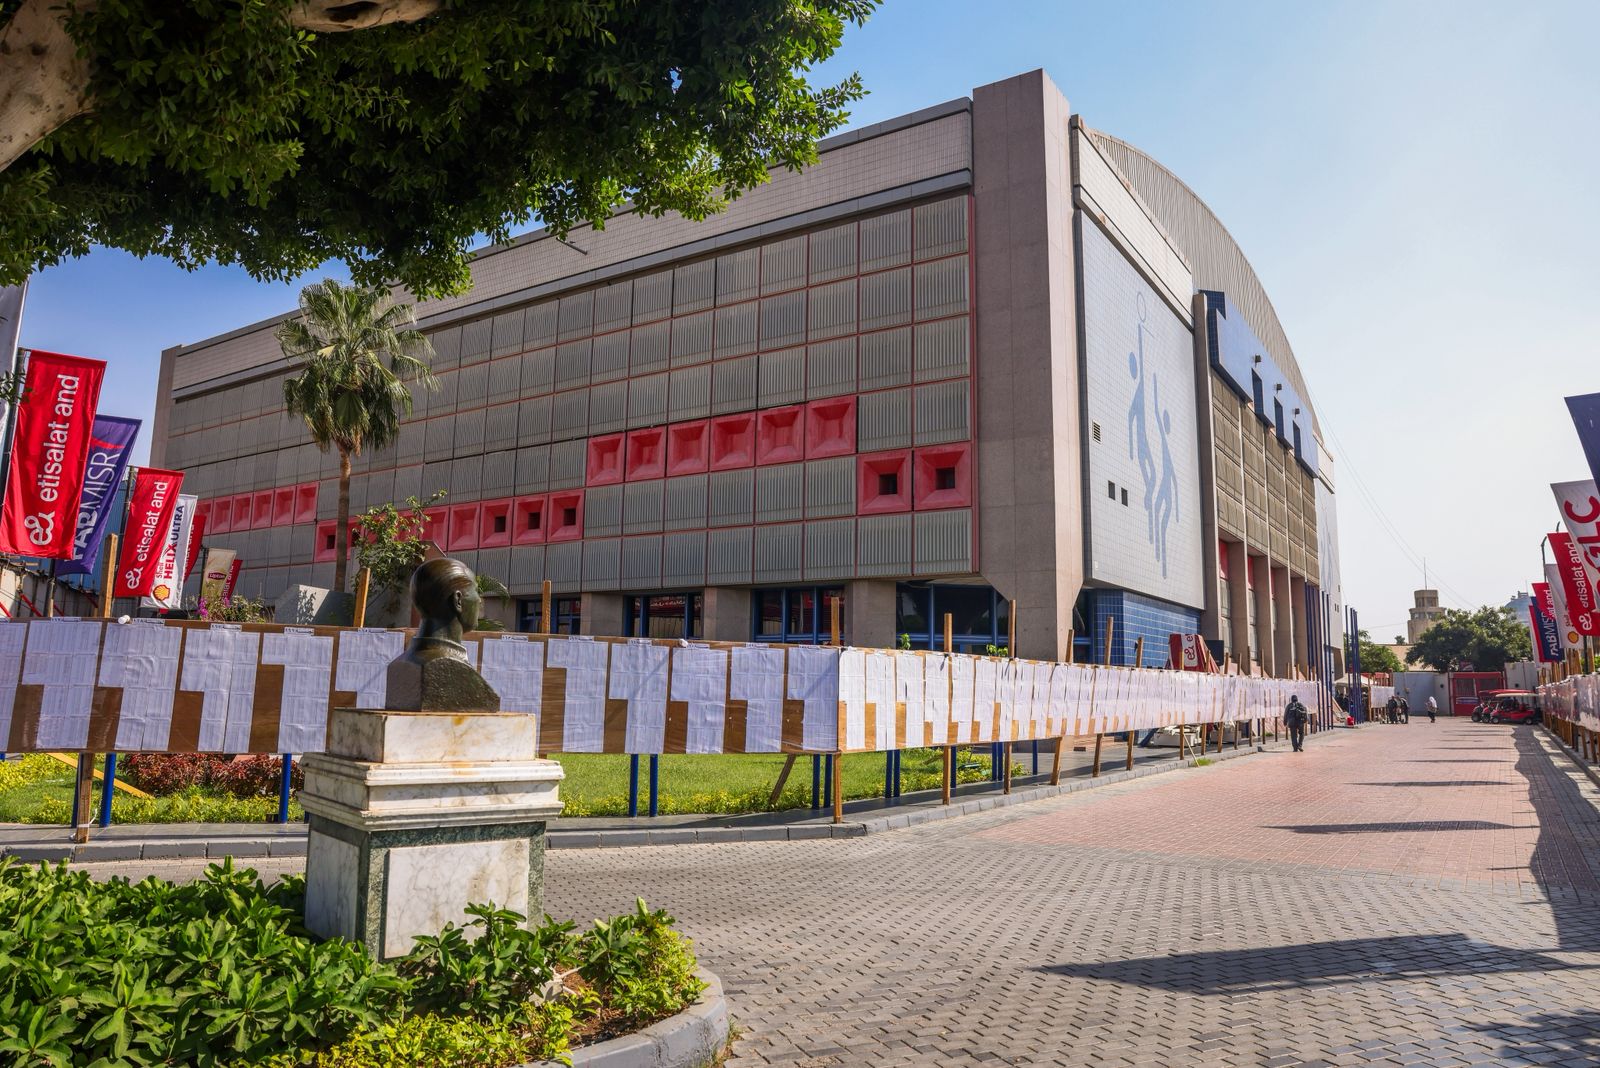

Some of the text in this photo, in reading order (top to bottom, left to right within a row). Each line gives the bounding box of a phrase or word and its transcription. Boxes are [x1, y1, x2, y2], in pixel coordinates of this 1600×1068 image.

[37, 421, 70, 502] etisalat
[55, 374, 80, 417] and
[136, 510, 160, 562] etisalat
[151, 481, 169, 508] and
[163, 505, 184, 579] HELIX ULTRA
[1564, 542, 1581, 564] and
